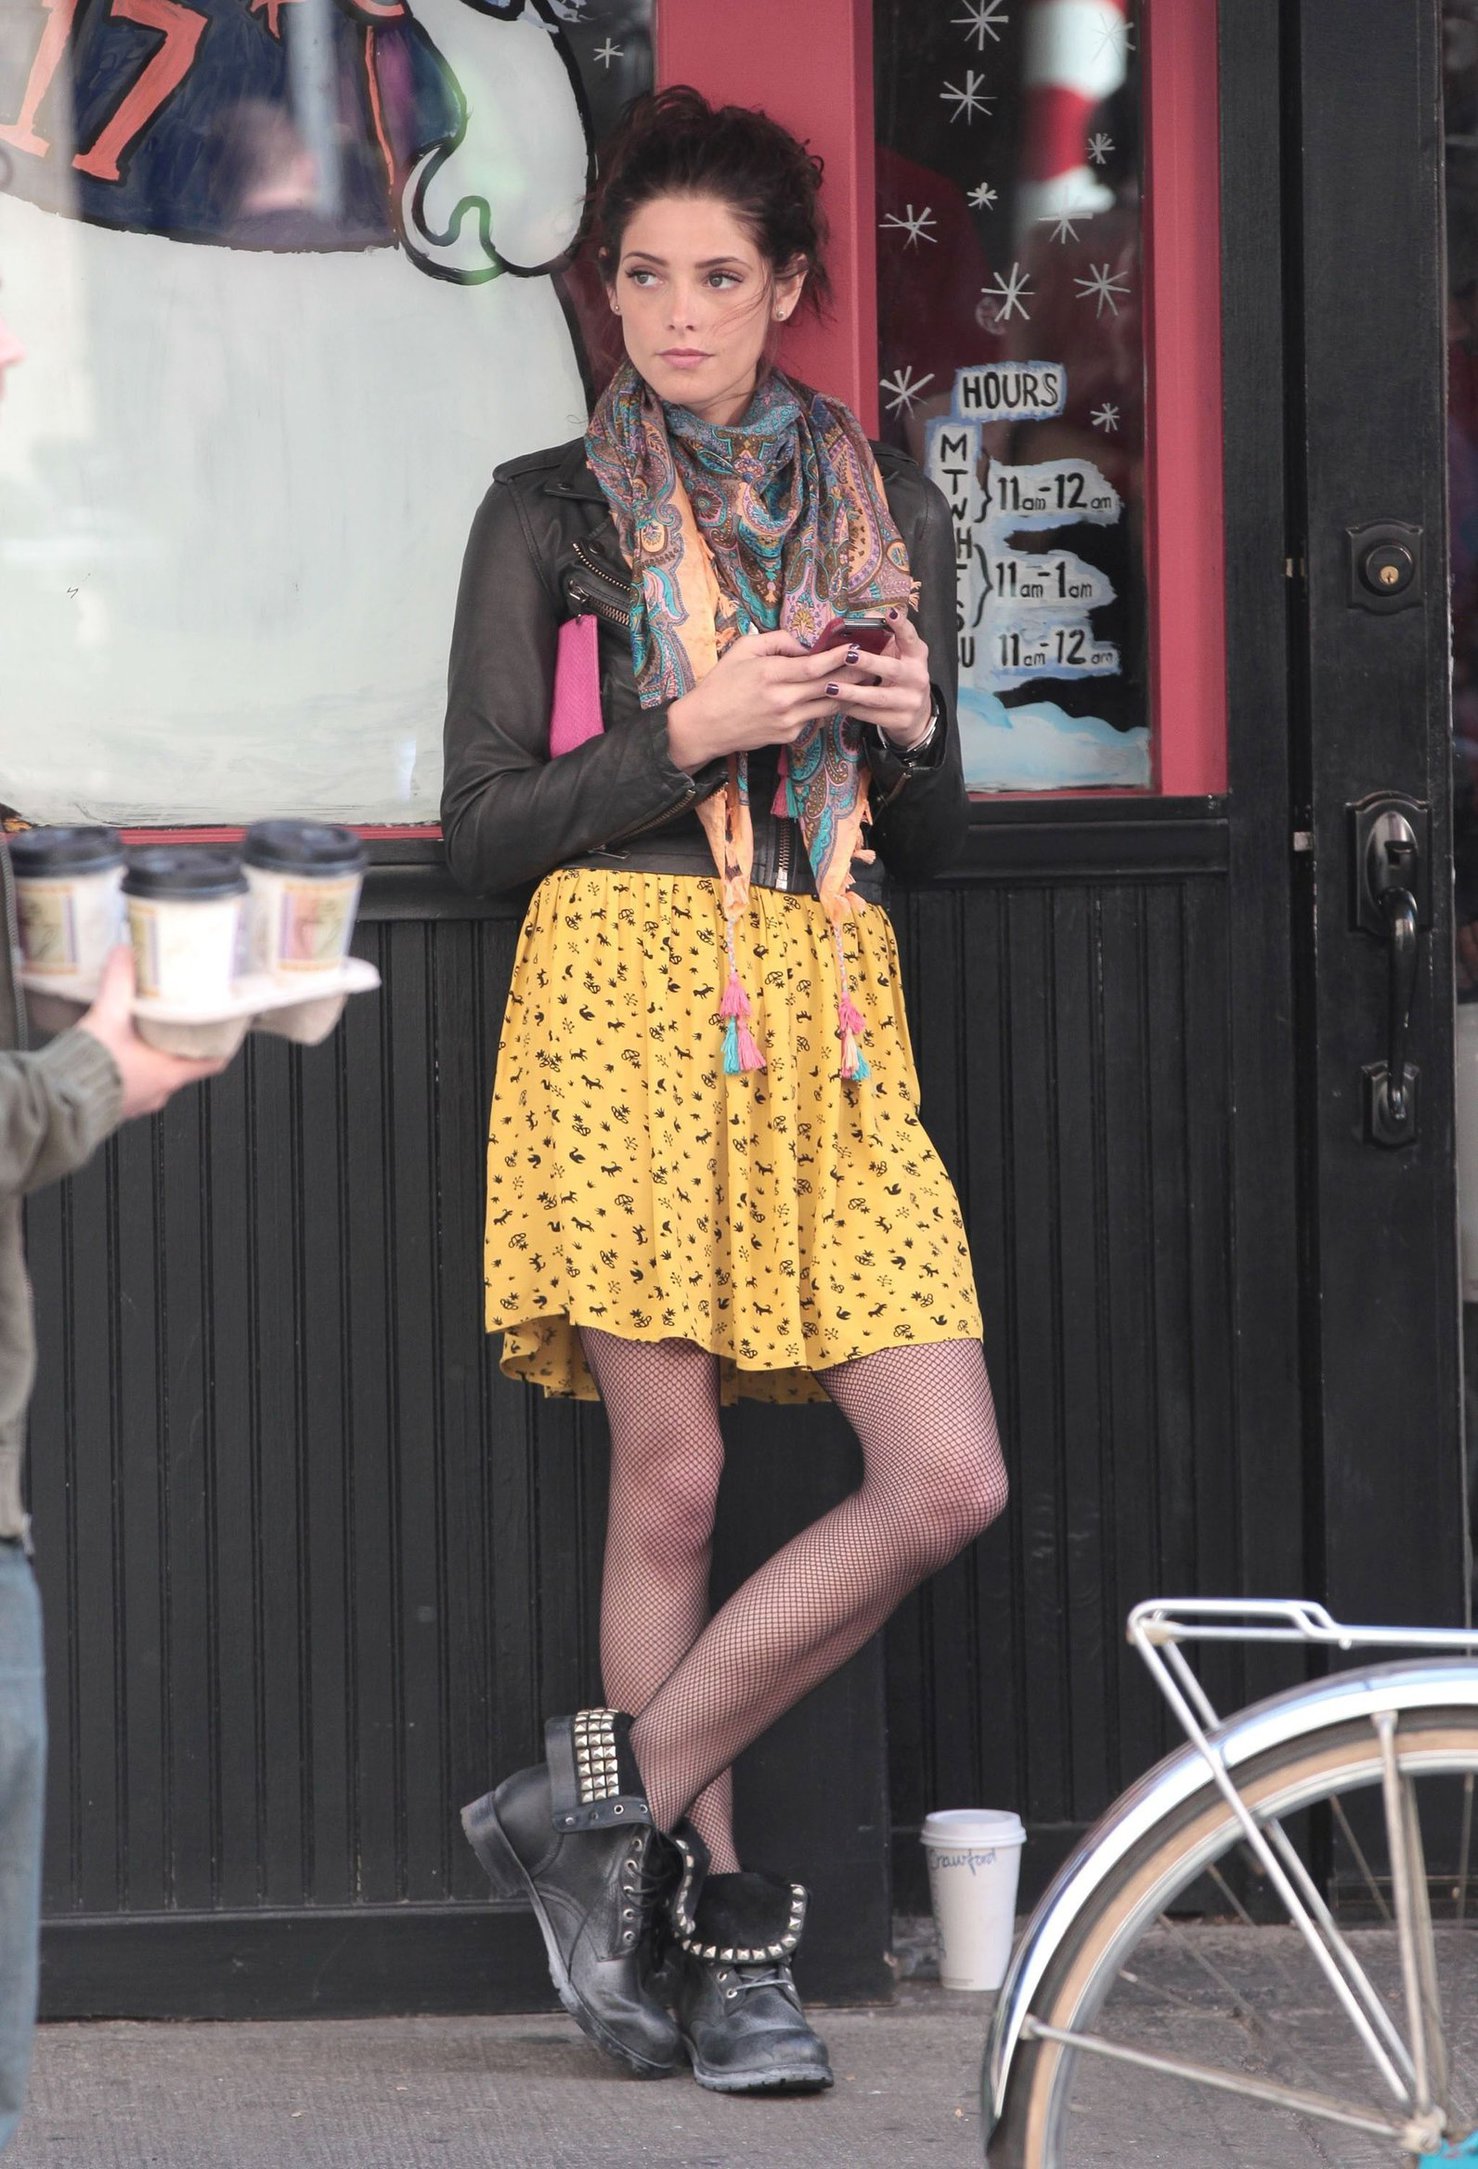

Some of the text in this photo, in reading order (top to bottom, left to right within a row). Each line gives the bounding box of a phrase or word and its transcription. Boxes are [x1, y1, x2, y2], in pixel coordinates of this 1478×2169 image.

[963, 372, 1059, 408] HOURS
[940, 433, 968, 462] M
[942, 468, 969, 495] T
